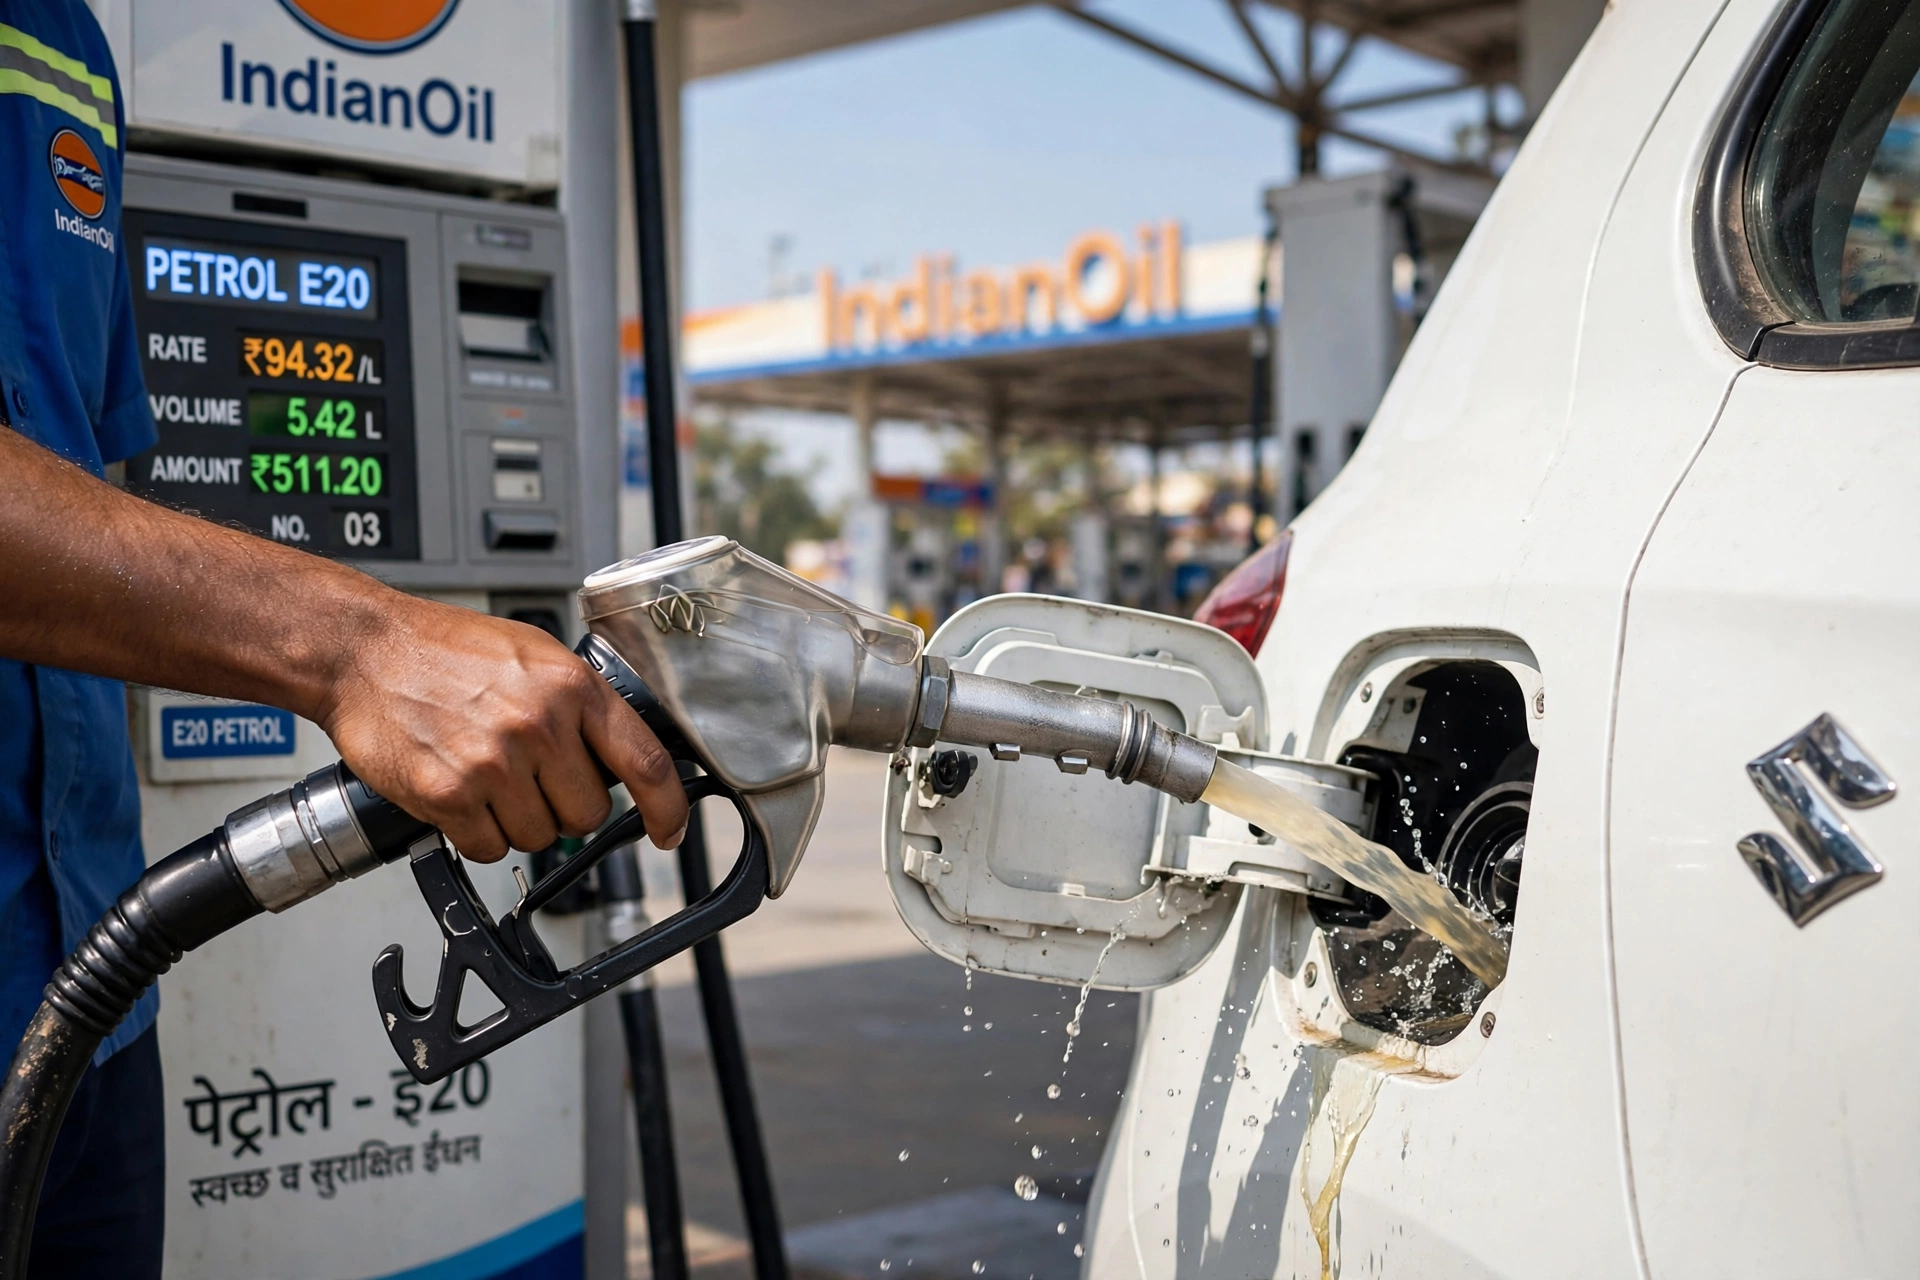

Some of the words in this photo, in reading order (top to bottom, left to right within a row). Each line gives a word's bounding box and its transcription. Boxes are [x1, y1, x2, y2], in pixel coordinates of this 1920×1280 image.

[221, 42, 495, 143] IndianOil
[54, 208, 114, 253] IndianOil
[146, 246, 288, 303] PETROL
[299, 262, 370, 310] E20
[815, 217, 1183, 349] IndianOil
[149, 333, 207, 363] RATE
[150, 396, 242, 426] VOLUME
[287, 398, 357, 439] 5.42
[365, 411, 382, 440] L
[151, 456, 243, 484] AMOUNT
[250, 454, 382, 496] ₹511.20
[272, 515, 310, 541] NO.
[344, 512, 381, 546] 03
[172, 719, 209, 747] E20
[212, 716, 285, 745] PETROL
[184, 1067, 336, 1158] पेट्रोल
[189, 1167, 271, 1208] स्वच्छ
[277, 1161, 302, 1192] व
